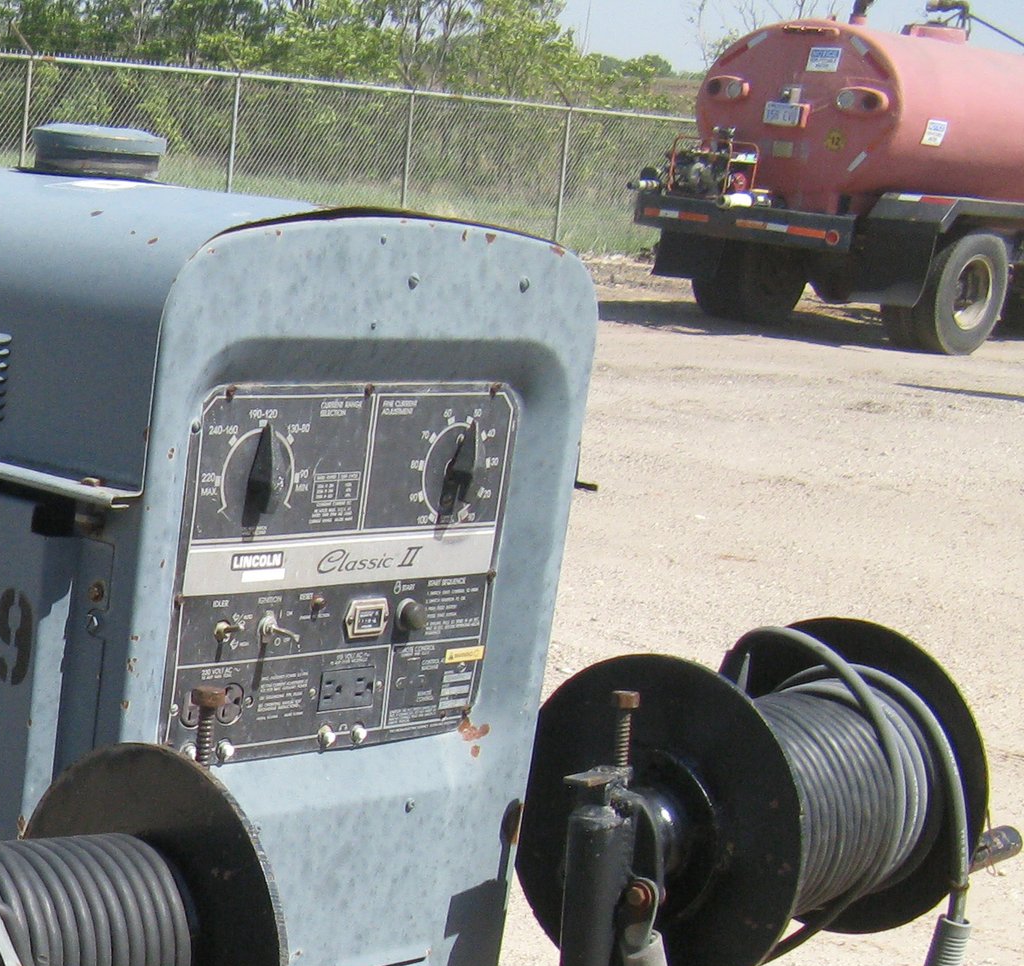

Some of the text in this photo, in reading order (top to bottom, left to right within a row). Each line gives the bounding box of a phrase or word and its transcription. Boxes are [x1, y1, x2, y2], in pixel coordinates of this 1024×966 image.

[248, 409, 278, 419] 190-120
[443, 409, 453, 418] 60
[208, 425, 239, 436] 240-160
[287, 423, 311, 434] 130-80
[486, 428, 496, 438] 40
[420, 430, 430, 440] 70
[410, 459, 419, 469] 80
[490, 457, 499, 466] 30
[201, 472, 215, 483] 220
[409, 493, 419, 502] 90
[481, 489, 492, 498] 20
[416, 515, 429, 524] 100
[233, 553, 282, 569] LINCOLN
[316, 545, 423, 574] Classic II
[212, 599, 230, 608] IDLER
